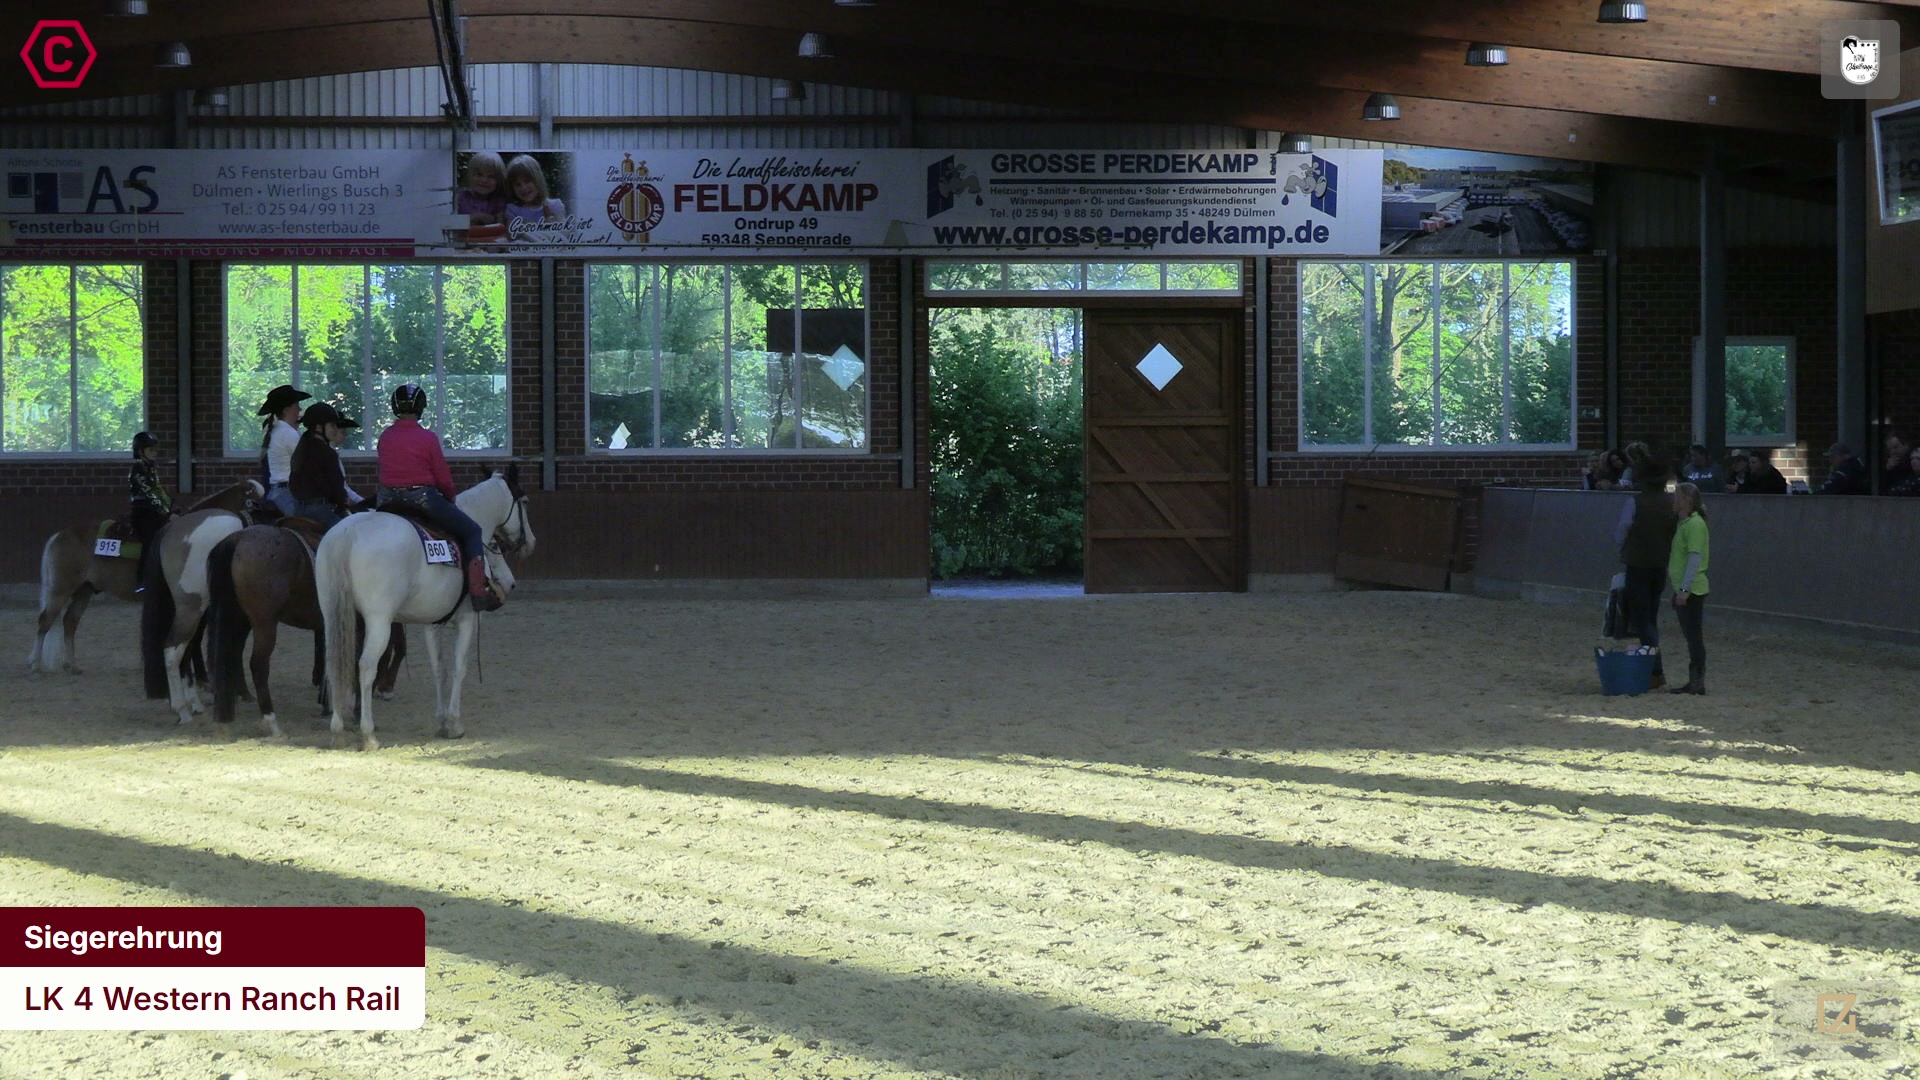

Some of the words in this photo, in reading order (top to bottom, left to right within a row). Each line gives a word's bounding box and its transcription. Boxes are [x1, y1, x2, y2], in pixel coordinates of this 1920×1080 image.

[692, 158, 722, 179] Die
[726, 156, 861, 184] Landfleischerei
[991, 153, 1096, 174] GROSSE
[1103, 153, 1259, 174] PERDEKAMP
[217, 166, 237, 179] AS
[241, 165, 327, 179] Fensterbau
[332, 165, 380, 179] GmbH
[86, 165, 160, 214] AS
[192, 183, 253, 198] Dülmen
[267, 183, 338, 200] Wierlings
[343, 183, 389, 198] Busch
[395, 184, 404, 197] 3
[990, 186, 1028, 197] Heizung
[1037, 186, 1070, 195] Sanitär
[1079, 186, 1137, 195] Brunnenbau
[1145, 186, 1170, 195] Solar
[1178, 186, 1277, 197] Erdwärmebohrungen
[673, 183, 879, 212] FELDKAMP
[1010, 196, 1081, 206] Wärmepumpen
[1107, 197, 1126, 205] und
[1129, 197, 1257, 207] Gasfeuerungskundendienst
[223, 203, 253, 216] Tel.:
[990, 208, 1008, 218] Tel.
[1026, 208, 1038, 218] 25
[1074, 208, 1087, 218] 88
[1090, 208, 1103, 218] 50
[1110, 208, 1172, 220] Dernekamp
[1175, 209, 1188, 217] 35
[1198, 209, 1230, 217] 48249
[1233, 207, 1276, 217] Dülmen
[607, 202, 664, 233] FELDKAMP
[734, 217, 795, 233] Ondrup
[799, 217, 818, 230] 49
[9, 219, 104, 234] Fensterbau
[109, 219, 160, 234] GmbH
[218, 219, 381, 234] www.as-fensterbau.de
[509, 214, 575, 237] Geschmack
[576, 216, 594, 230] ist
[701, 233, 750, 245] 59348
[755, 233, 852, 245] Seppenrade
[933, 220, 1330, 249] www.grosse-perdekamp.de
[99, 541, 117, 552] 915
[427, 543, 446, 557] 860
